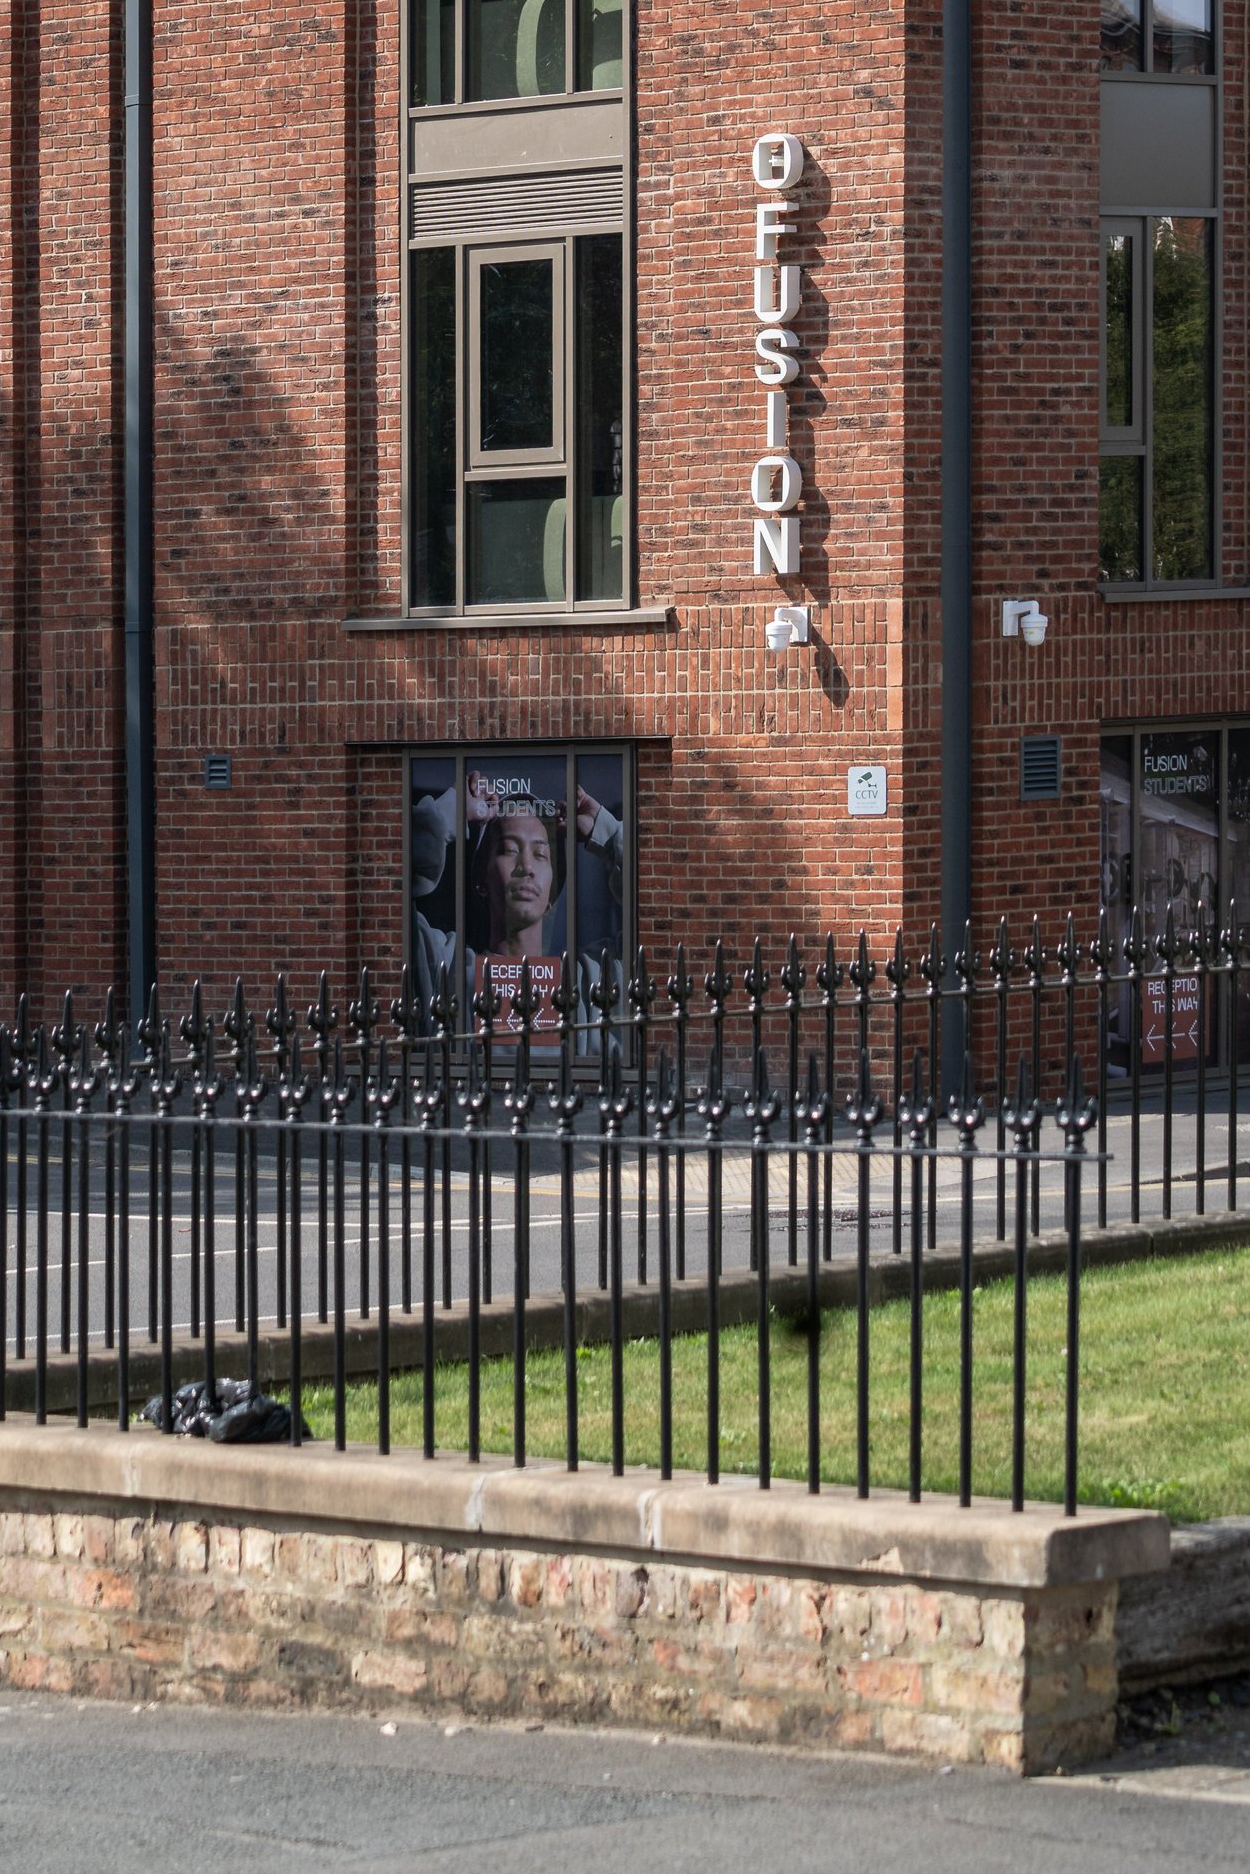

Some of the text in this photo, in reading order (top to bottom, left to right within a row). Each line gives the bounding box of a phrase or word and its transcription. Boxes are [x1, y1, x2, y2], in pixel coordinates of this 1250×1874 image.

[1144, 755, 1188, 773] FUSION
[477, 778, 530, 795] FUSION
[1143, 774, 1208, 796] STUDENTS
[855, 790, 879, 800] CCTV
[477, 799, 556, 817] STUDENTS
[482, 964, 554, 979] ECEPION
[1147, 977, 1201, 996] RECPTIO
[1152, 996, 1199, 1014] THS WAY
